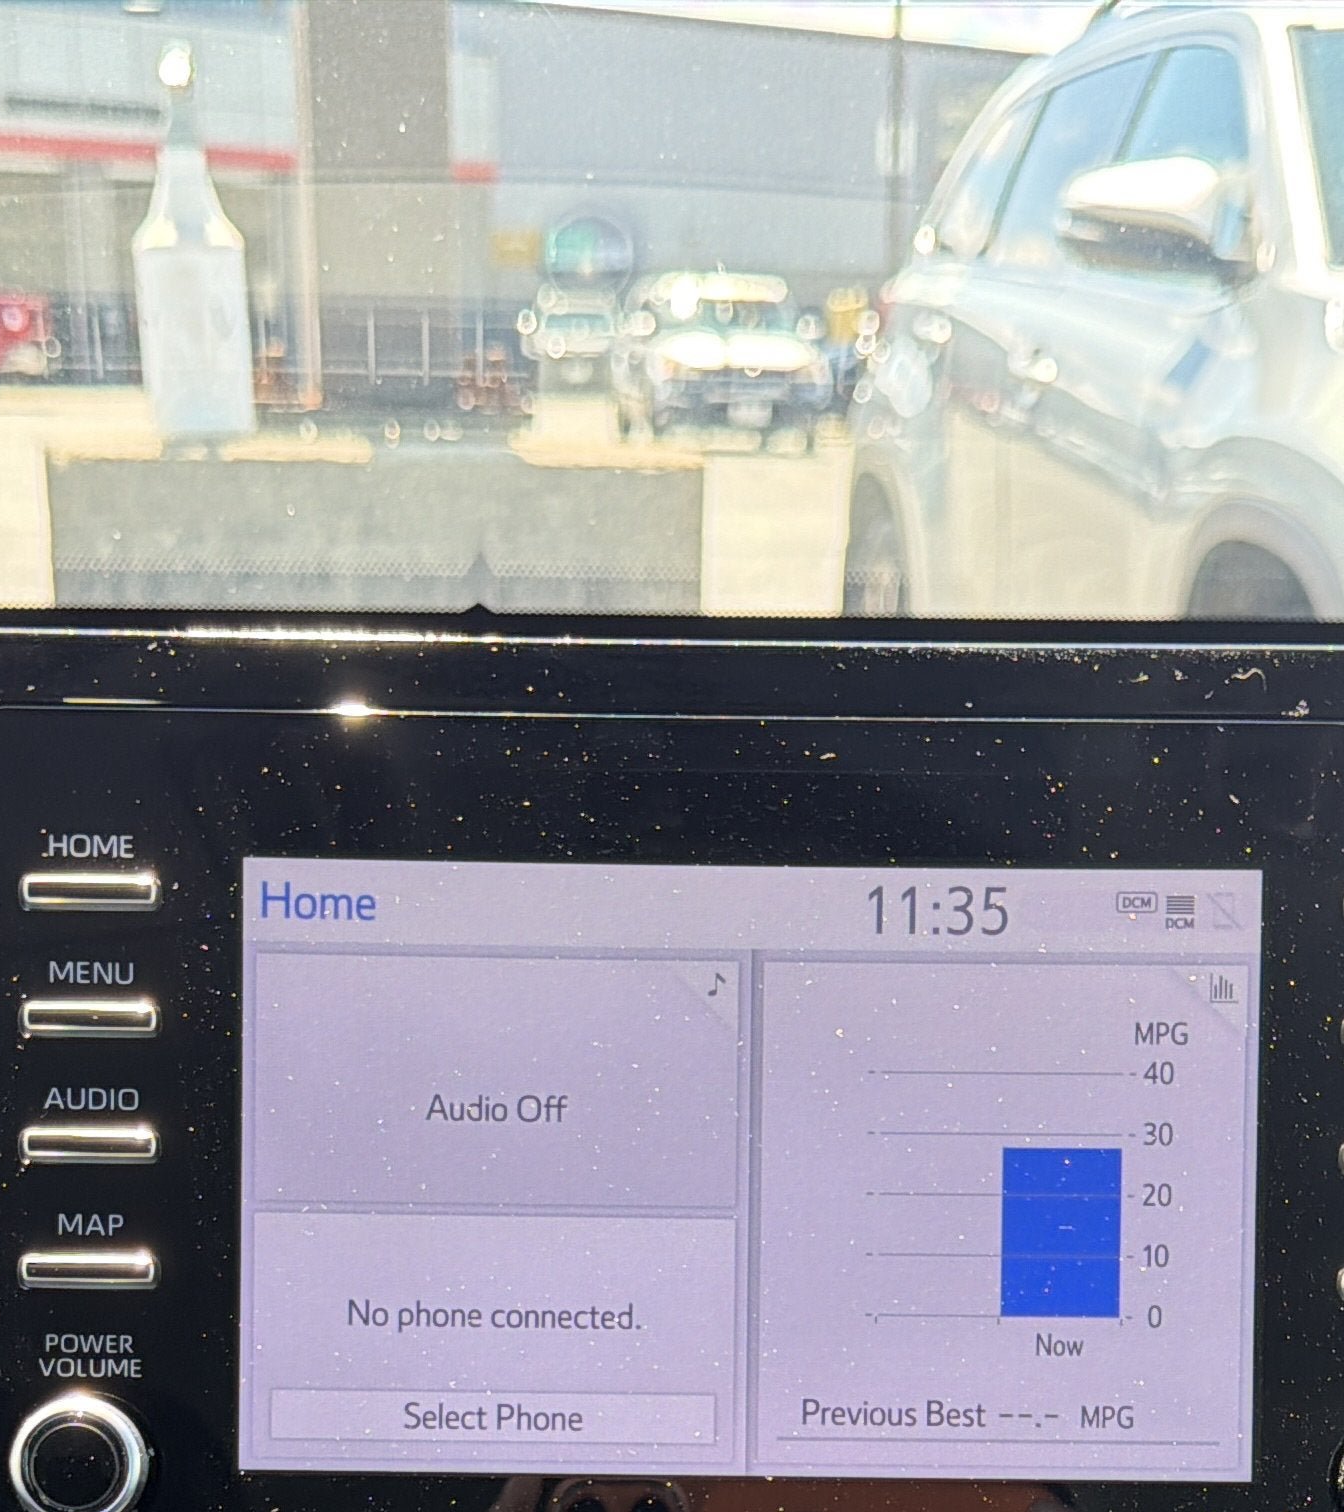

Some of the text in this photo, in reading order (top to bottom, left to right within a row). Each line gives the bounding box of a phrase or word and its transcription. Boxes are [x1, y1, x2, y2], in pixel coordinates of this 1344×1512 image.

[49, 835, 133, 858] HOME
[260, 881, 377, 921] Home
[867, 885, 1010, 936] 11:35
[1122, 895, 1153, 909] DCM
[1165, 917, 1195, 930] DCM
[48, 961, 134, 985] MENU
[1134, 1022, 1189, 1047] MPG
[1143, 1062, 1175, 1086] 40
[44, 1088, 139, 1112] AUDIO
[426, 1094, 569, 1123] Audio Off
[1143, 1123, 1173, 1147] 30
[1142, 1184, 1172, 1208] 20
[57, 1213, 124, 1237] MAP
[1144, 1245, 1170, 1268] 10
[347, 1300, 642, 1336] No phone connected.
[1147, 1305, 1163, 1328] 0
[45, 1334, 133, 1355] POWER
[1034, 1333, 1084, 1357] Now
[39, 1358, 142, 1379] VOLUME
[403, 1402, 583, 1432] Select Phone
[801, 1398, 917, 1427] Previous
[926, 1401, 986, 1428] Best
[1080, 1405, 1135, 1430] MPG
